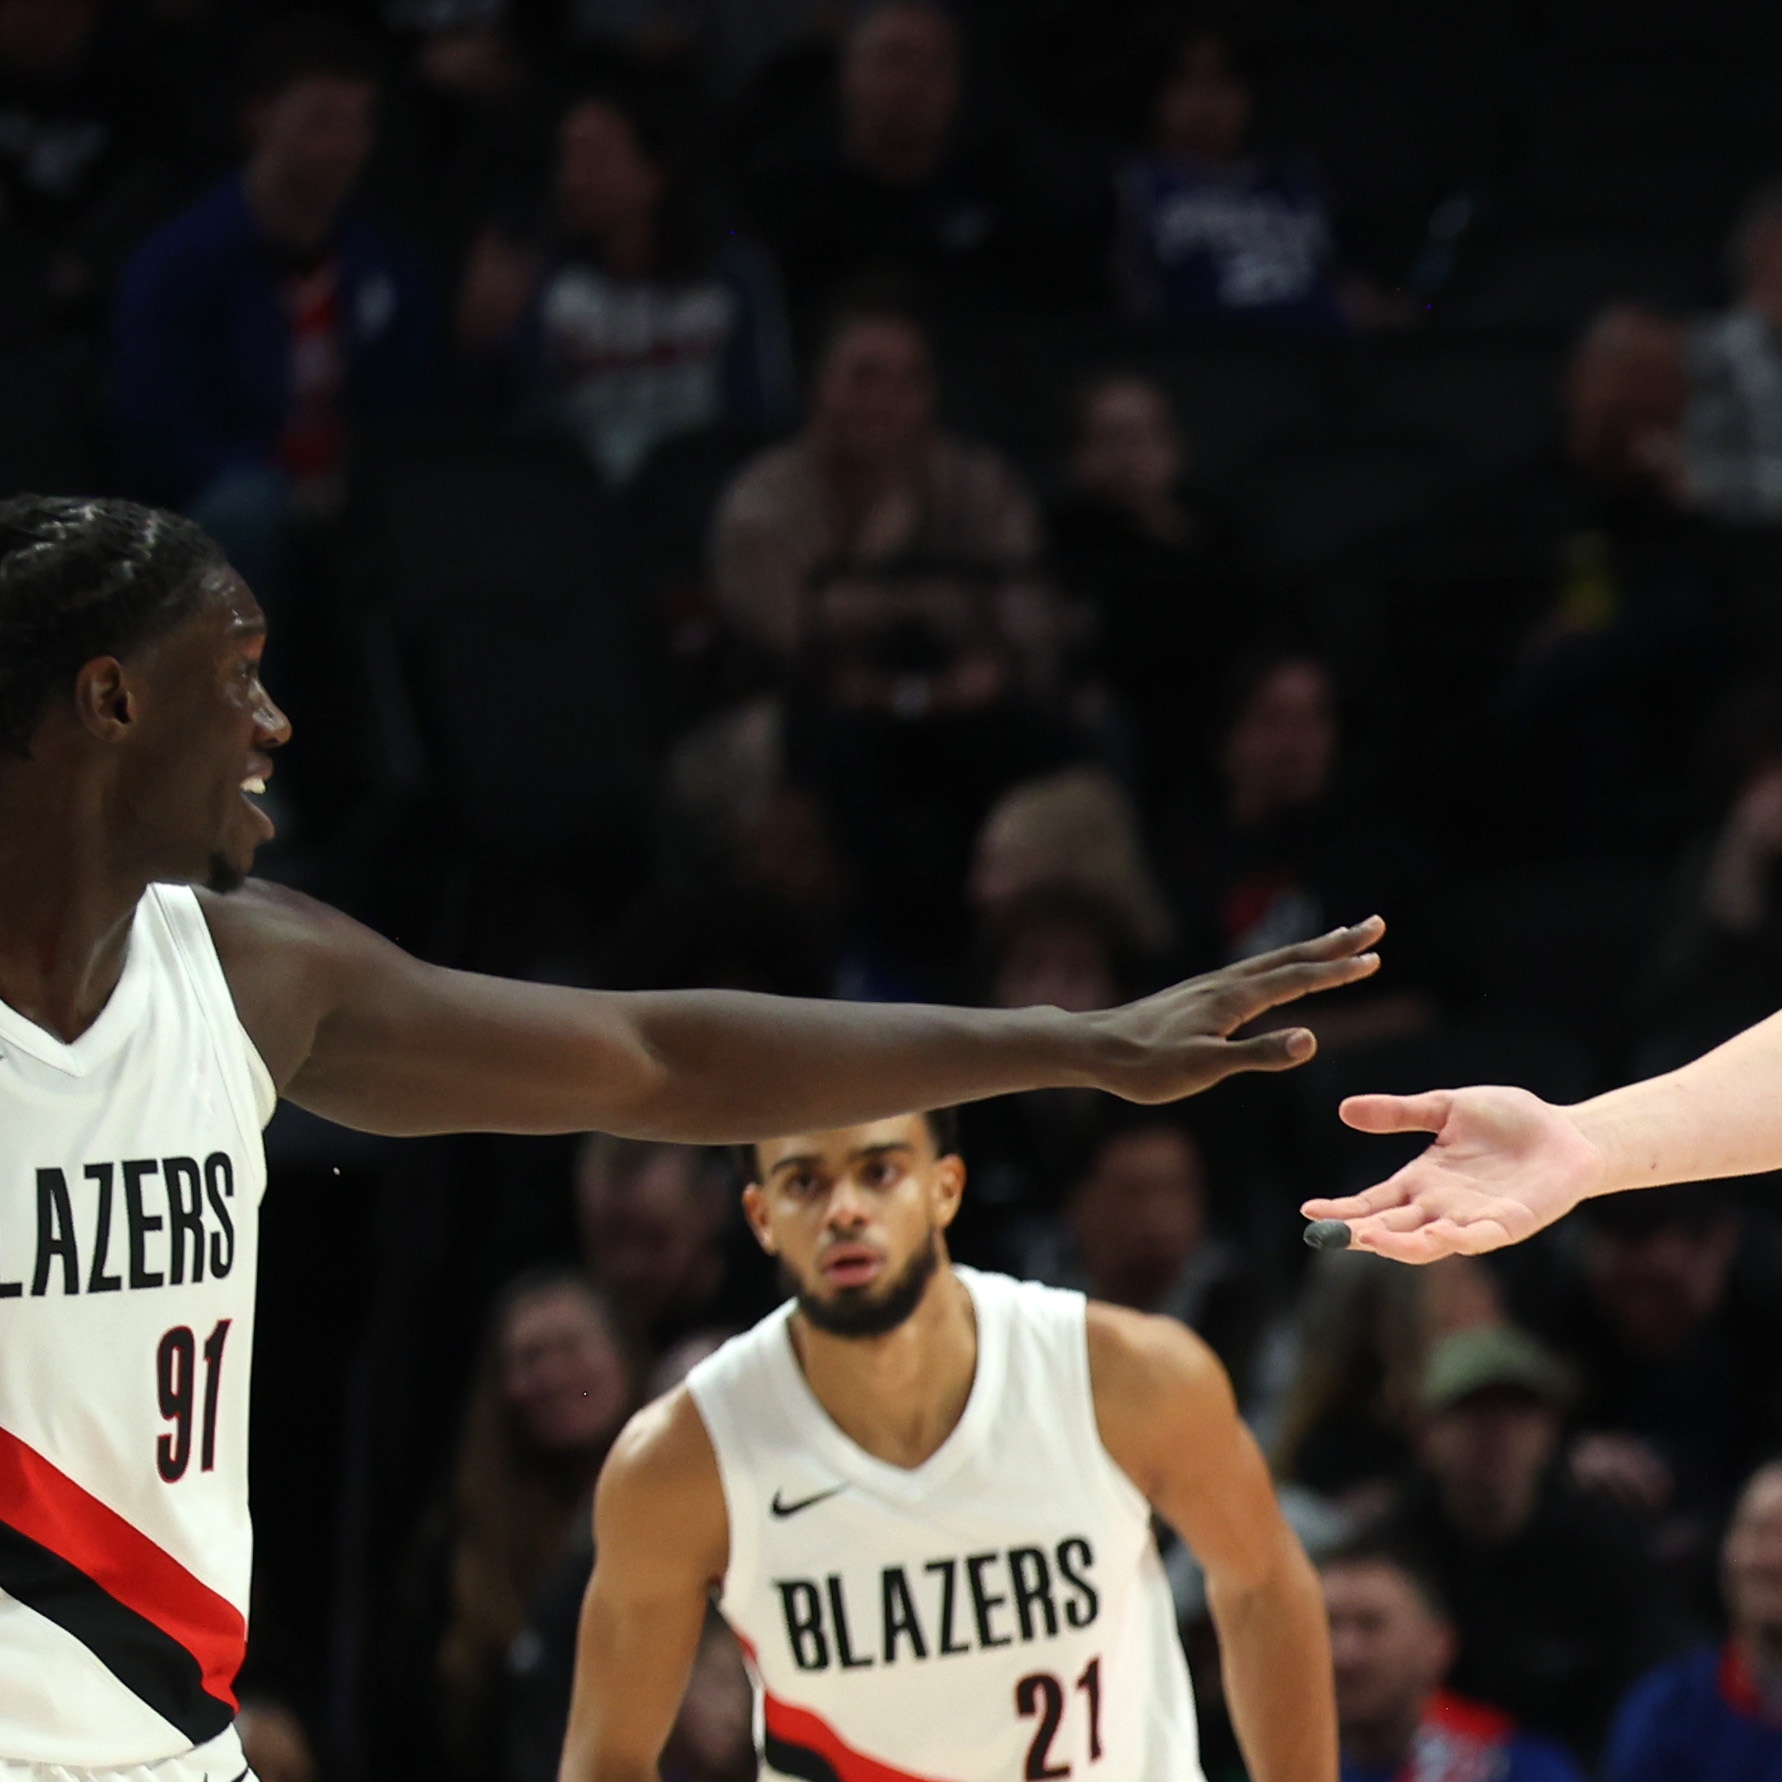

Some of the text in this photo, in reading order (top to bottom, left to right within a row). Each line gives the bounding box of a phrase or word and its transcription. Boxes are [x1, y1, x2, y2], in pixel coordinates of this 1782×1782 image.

[0, 1151, 234, 1298] AZERS
[156, 1318, 233, 1484] 91
[774, 1534, 1099, 1672] BLAZERS
